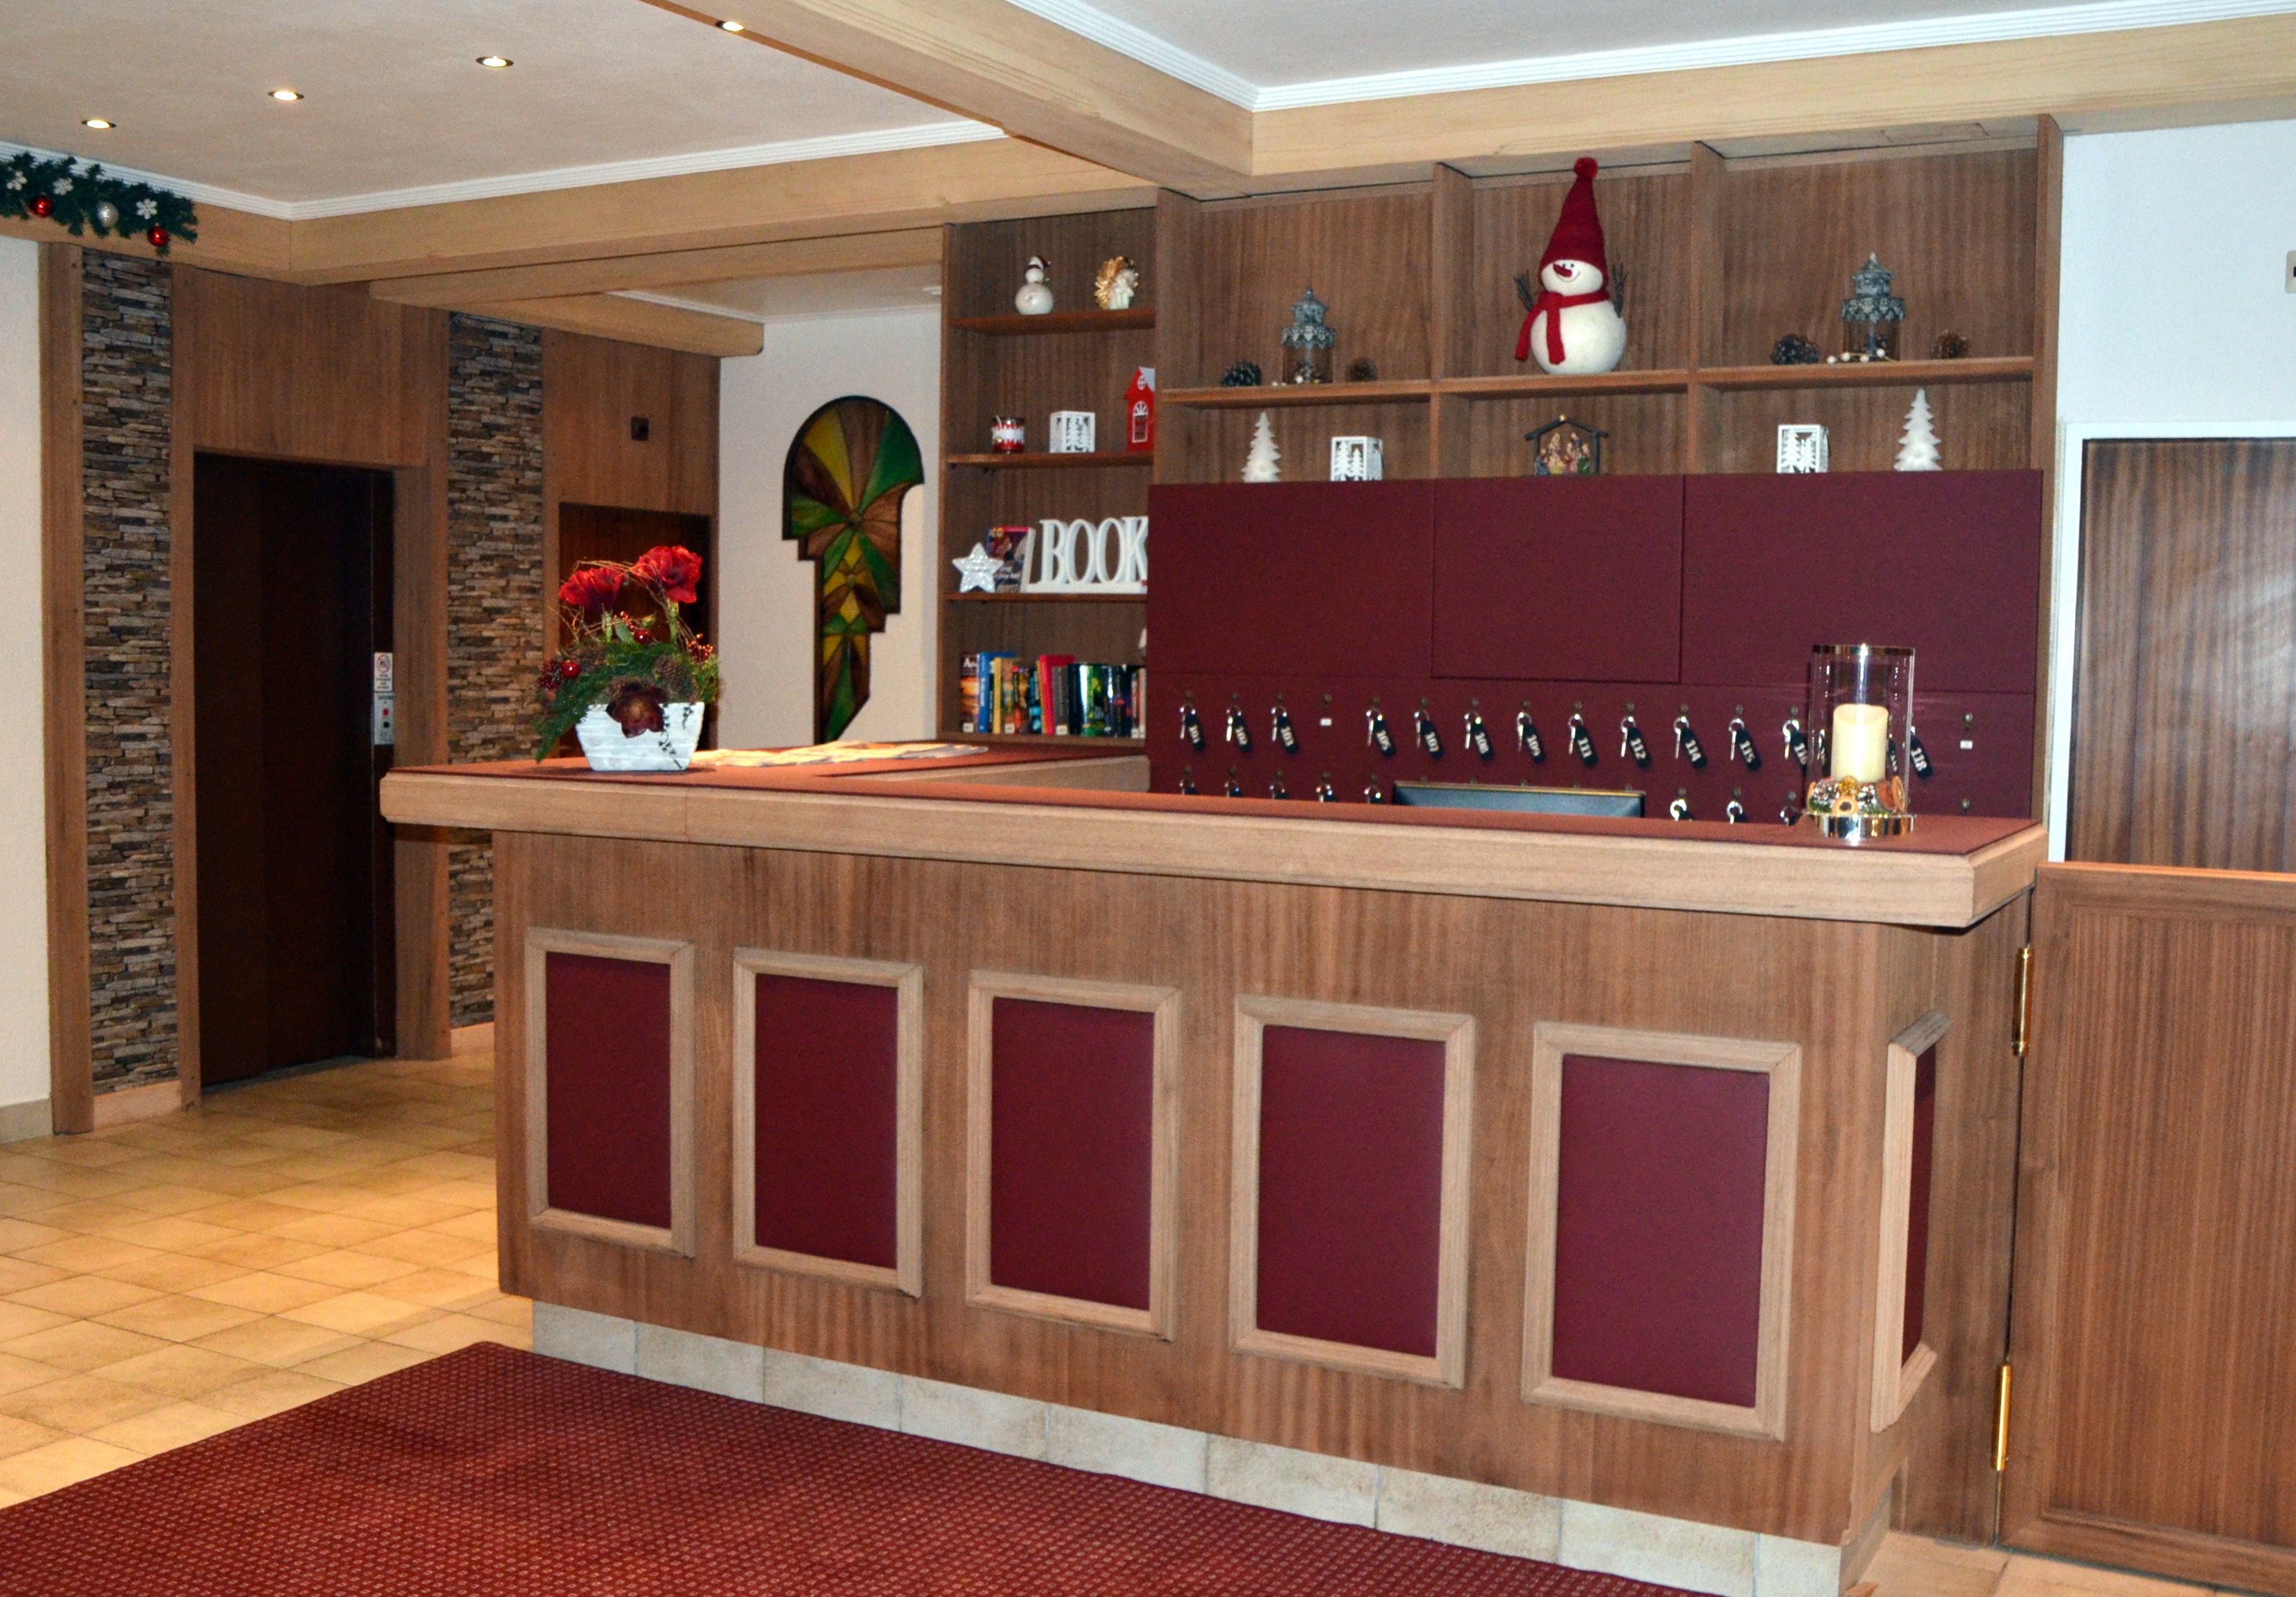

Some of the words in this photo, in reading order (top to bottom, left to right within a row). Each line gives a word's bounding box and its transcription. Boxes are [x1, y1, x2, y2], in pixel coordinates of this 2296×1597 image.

[1189, 724, 1201, 743] 101
[1281, 726, 1294, 746] 103
[1425, 732, 1439, 752] 107
[1526, 734, 1540, 756] 109
[1578, 737, 1592, 758] 111
[1630, 738, 1646, 759] 112
[1685, 740, 1701, 762] 114
[1739, 740, 1755, 763] 115
[1911, 747, 1927, 771] 118
